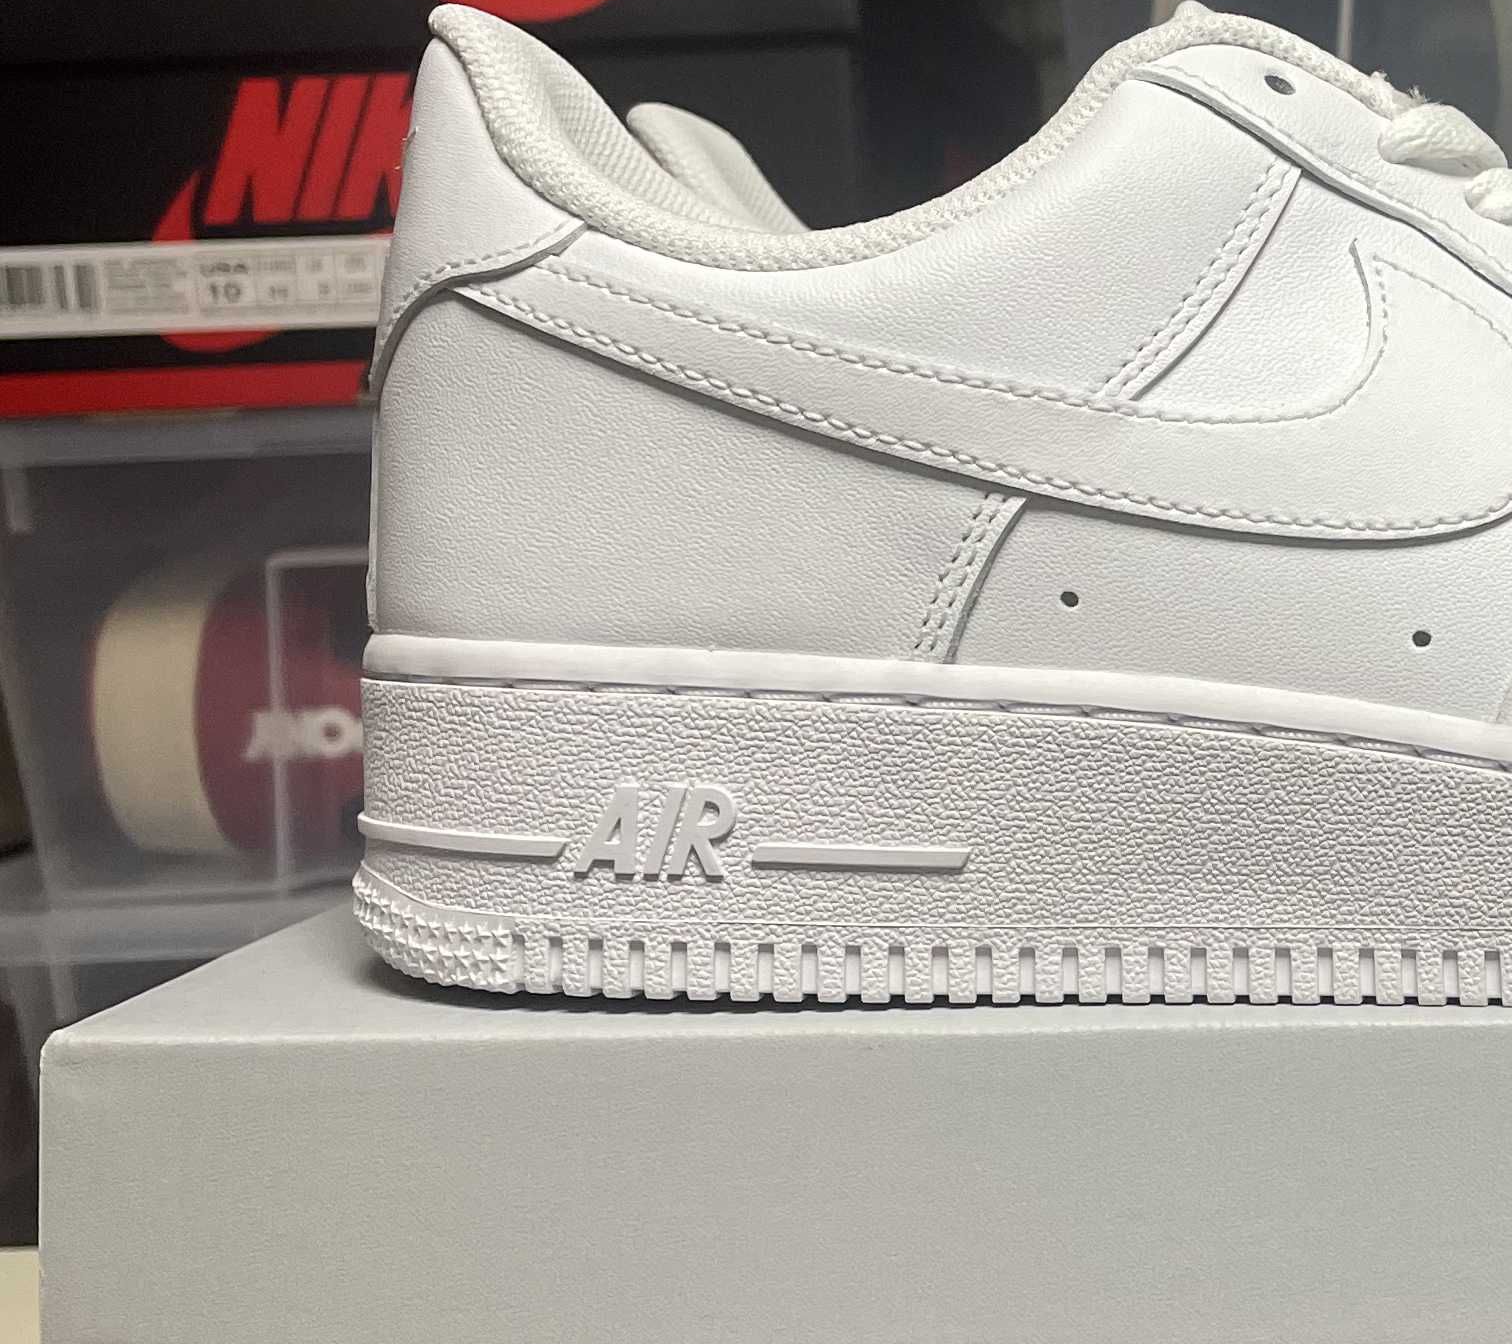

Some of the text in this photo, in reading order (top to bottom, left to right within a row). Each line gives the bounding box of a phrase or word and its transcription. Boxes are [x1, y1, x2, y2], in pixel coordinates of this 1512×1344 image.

[204, 72, 414, 225] NIK
[209, 281, 242, 304] 10
[574, 783, 740, 884] AIR
